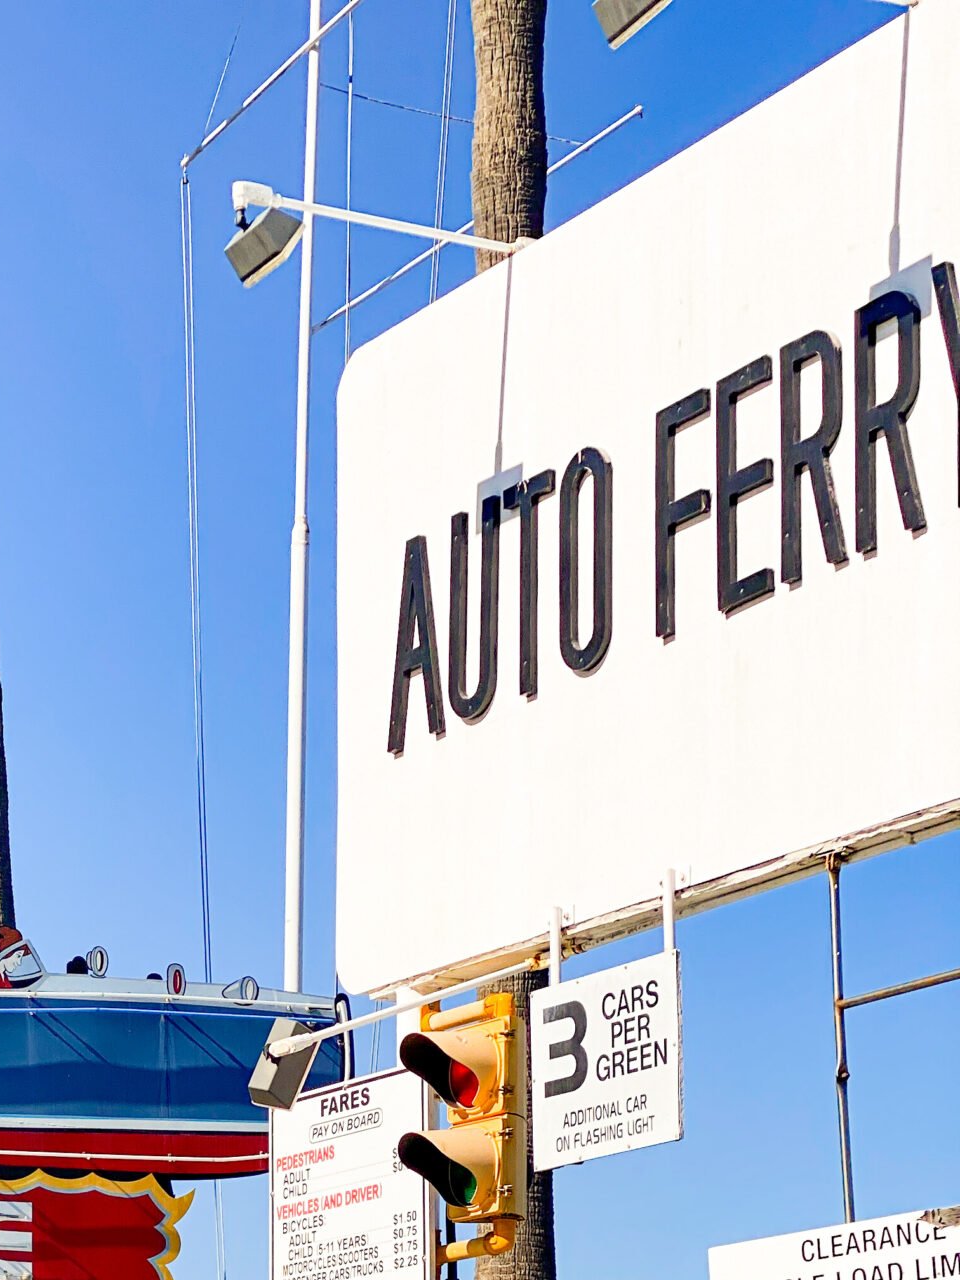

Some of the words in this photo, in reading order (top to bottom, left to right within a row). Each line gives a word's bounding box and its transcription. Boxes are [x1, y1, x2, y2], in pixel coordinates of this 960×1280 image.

[387, 446, 613, 757] AUTO
[602, 980, 659, 1020] CARS
[611, 1013, 650, 1048] PER
[543, 1000, 588, 1098] 3
[596, 1038, 668, 1082] GREEN
[320, 1087, 370, 1118] FARES
[563, 1101, 622, 1129] ADDITIONAL
[626, 1094, 648, 1114] CAR
[312, 1123, 330, 1140] PAY
[331, 1120, 344, 1134] ON
[346, 1111, 380, 1131] BOARD
[556, 1136, 570, 1153] ON
[574, 1123, 623, 1149] FLASHING
[627, 1115, 656, 1136] LIGHT
[276, 1145, 335, 1172] PEDESTRIANS
[283, 1168, 311, 1186] ADULT
[283, 1183, 308, 1200] CHILD
[276, 1198, 320, 1220] VEHICLES
[321, 1192, 343, 1211] (AND
[344, 1183, 382, 1206] DRIVER)
[288, 1246, 314, 1262] CHILD
[393, 1226, 418, 1240] $0.75
[289, 1231, 316, 1248] ADULT
[393, 1210, 417, 1226] $1.50
[801, 1222, 946, 1262] CLEARANCE
[394, 1240, 418, 1254] $1.75
[394, 1255, 418, 1270] $2.25
